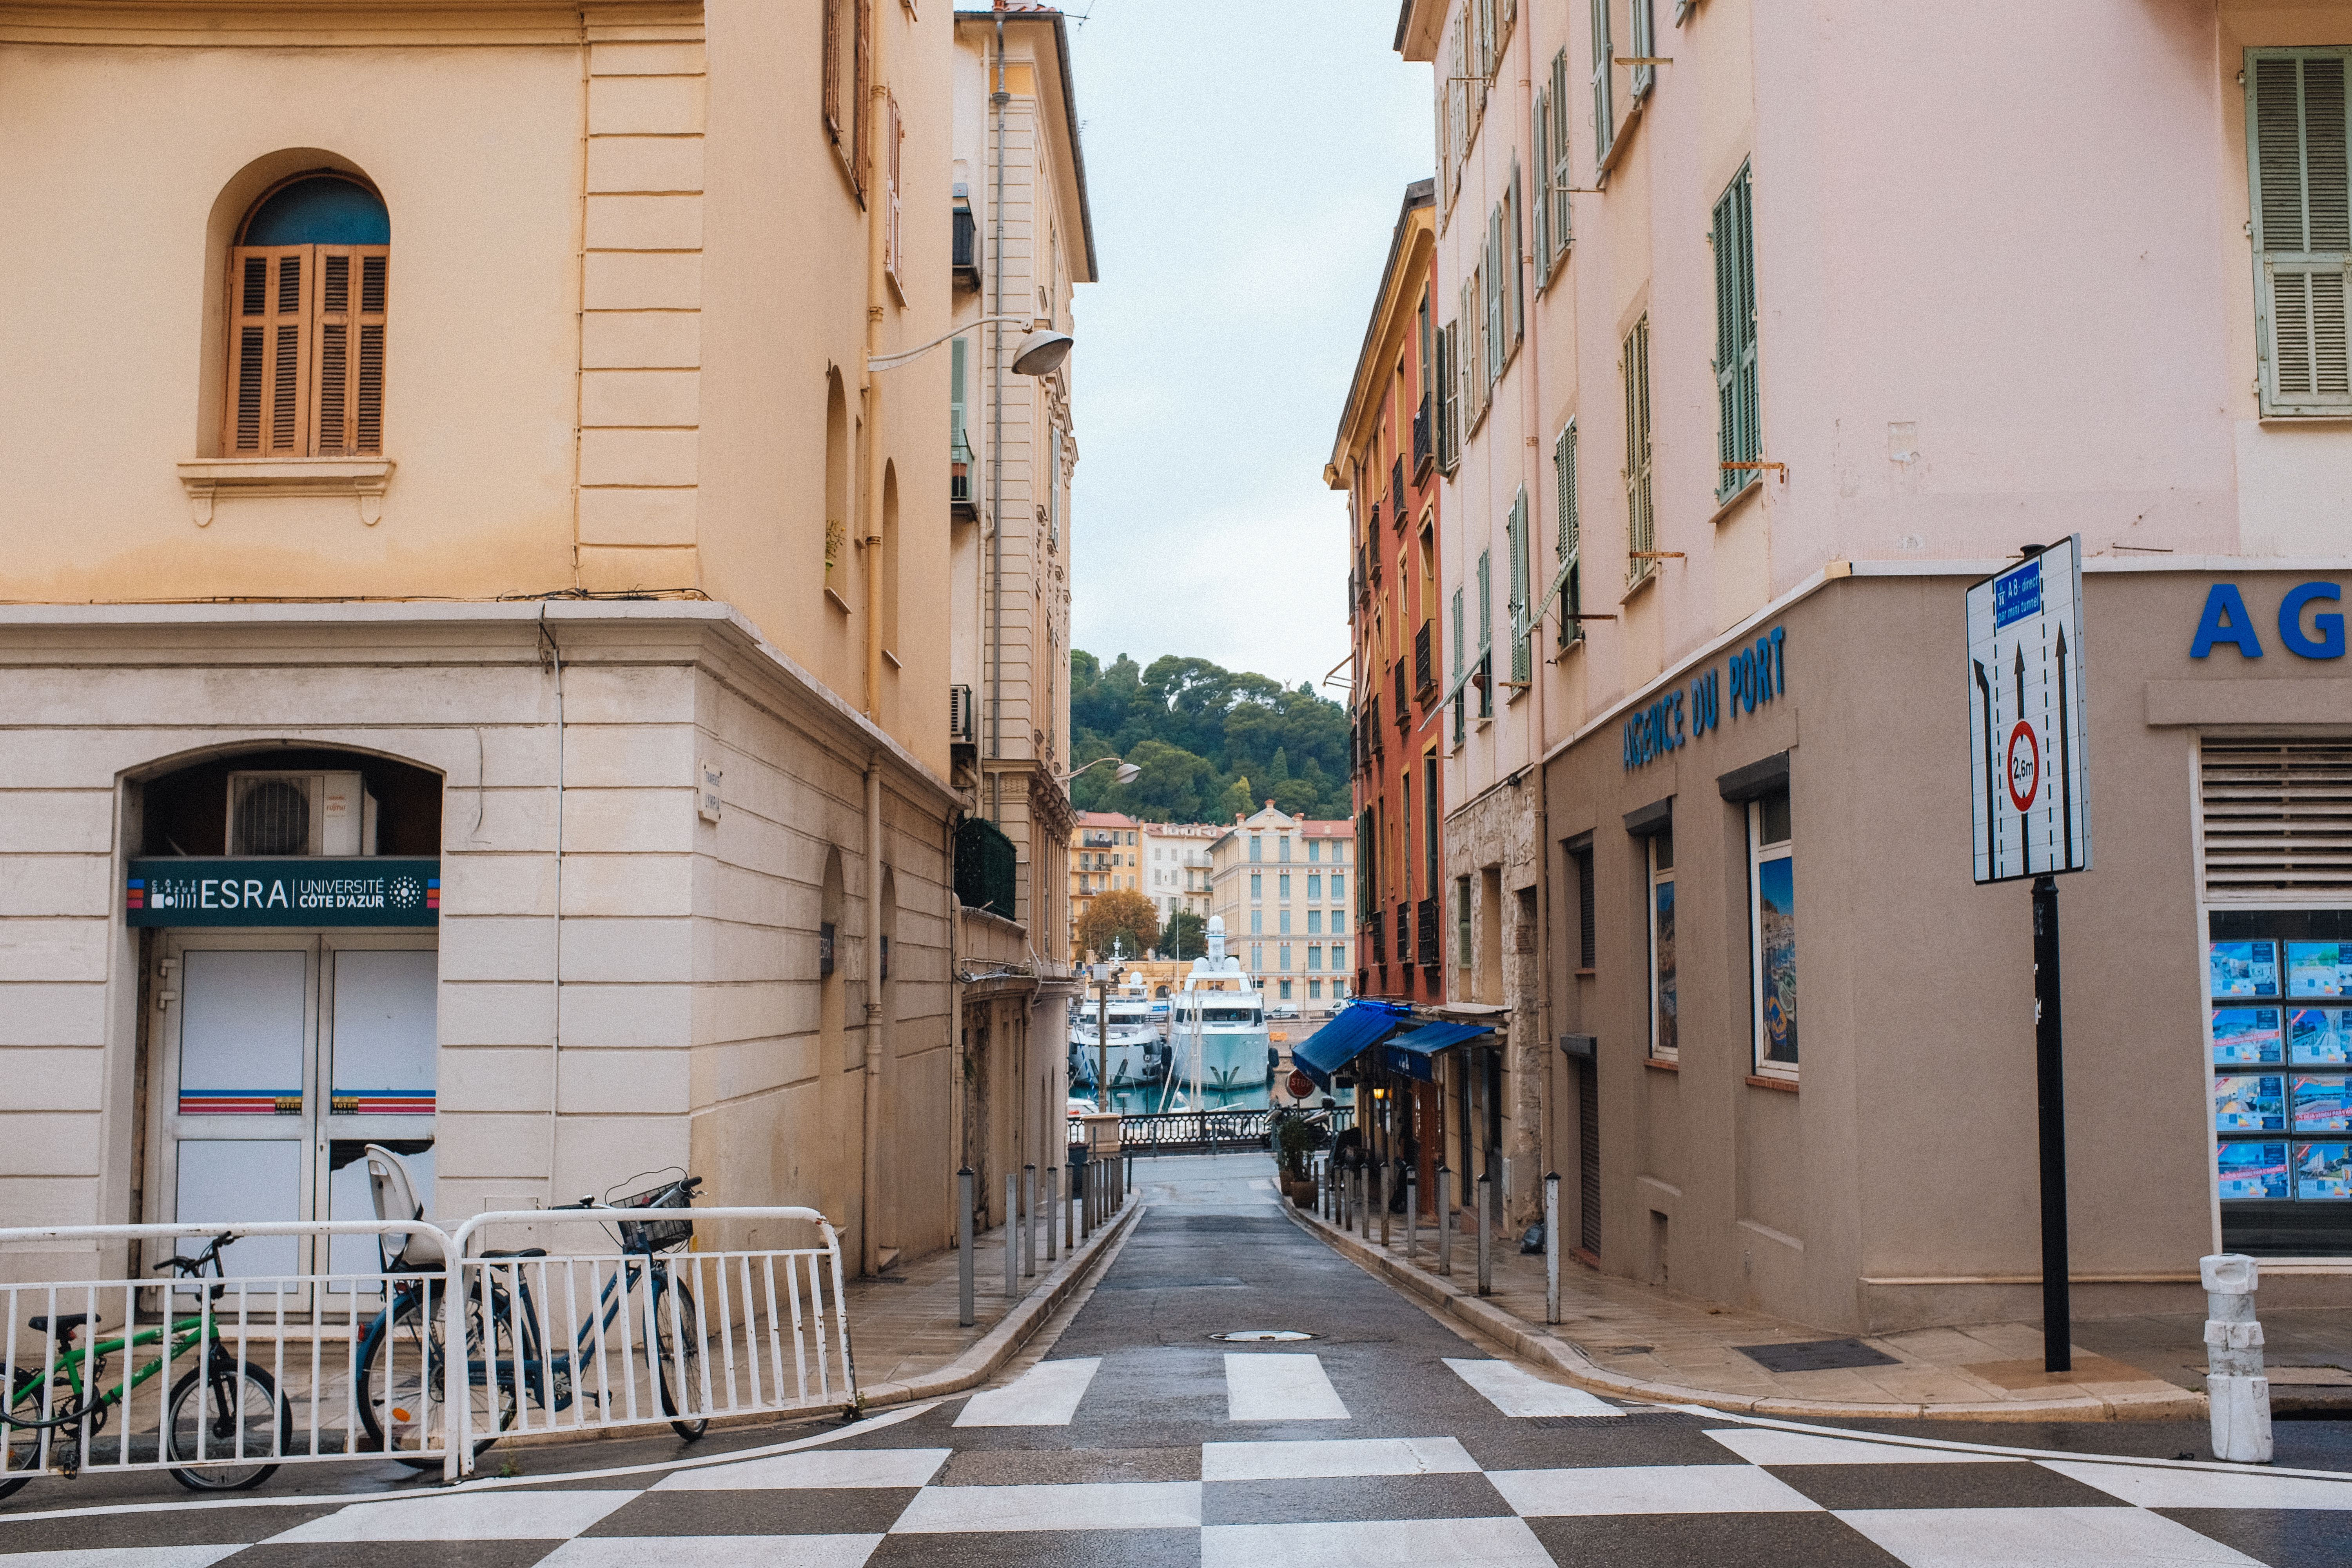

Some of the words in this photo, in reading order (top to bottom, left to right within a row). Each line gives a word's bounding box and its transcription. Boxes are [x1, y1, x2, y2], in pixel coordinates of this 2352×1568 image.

[2022, 574, 2038, 592] direct
[1998, 610, 2007, 626] par
[2008, 601, 2020, 619] mini
[2021, 592, 2039, 613] tunnel
[2190, 582, 2345, 660] AG
[1623, 689, 1684, 772] AGENCE
[1691, 667, 1716, 736] DU
[1729, 626, 1783, 718] PORT
[2013, 757, 2033, 782] 2,6m
[201, 879, 289, 909] ESRA
[300, 877, 385, 894] UNIVERSITÉ
[299, 891, 334, 908] CÔTE
[337, 895, 385, 908] D'AZUR
[1291, 1078, 1312, 1088] STOP
